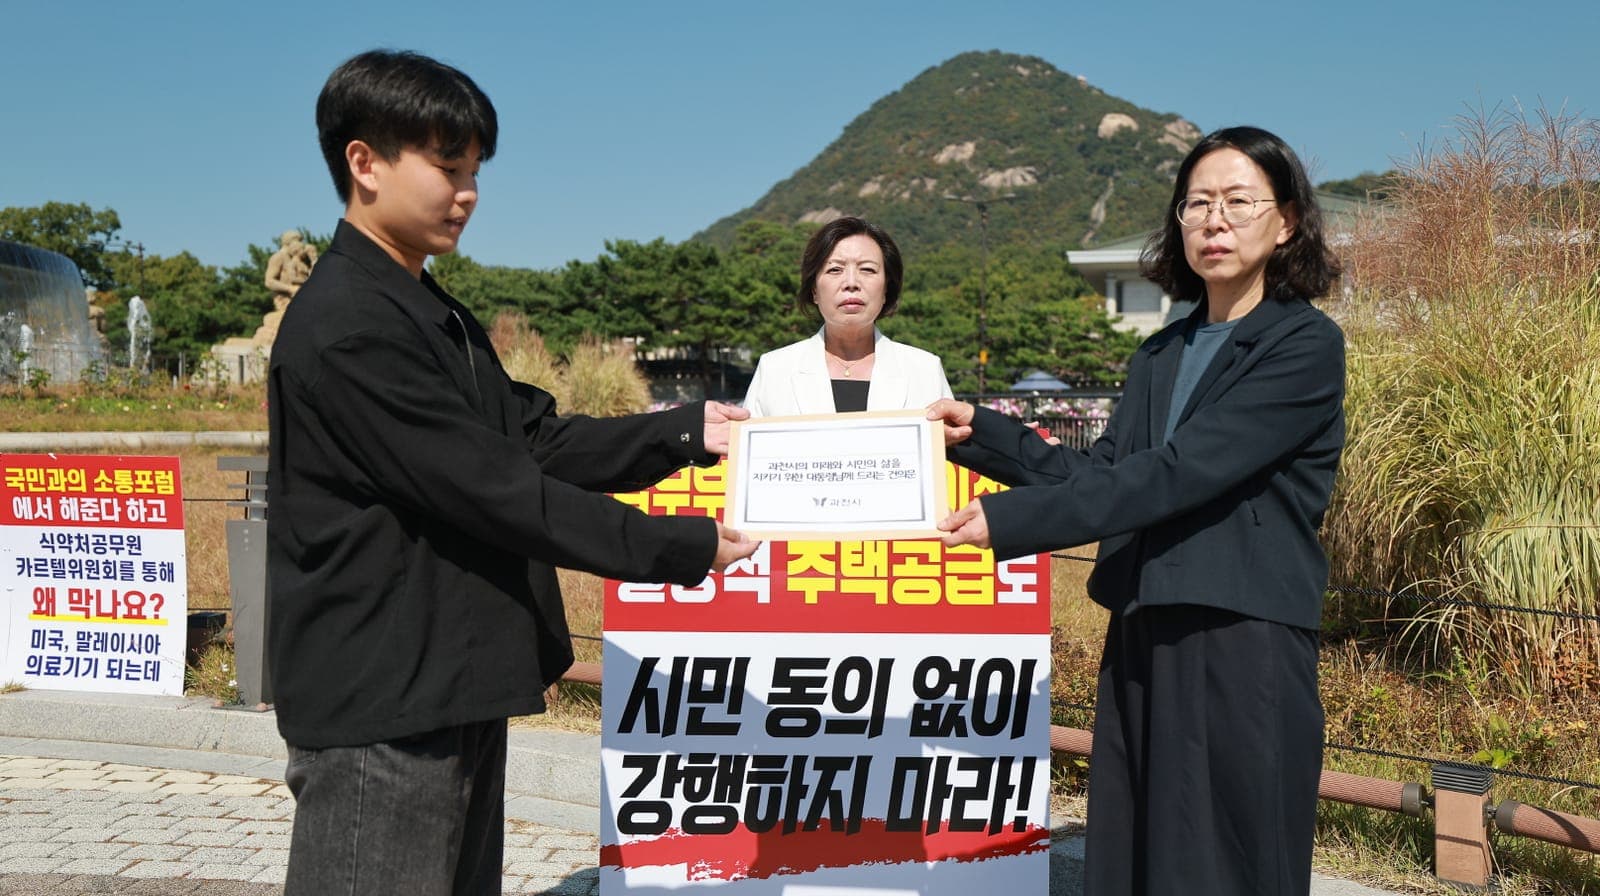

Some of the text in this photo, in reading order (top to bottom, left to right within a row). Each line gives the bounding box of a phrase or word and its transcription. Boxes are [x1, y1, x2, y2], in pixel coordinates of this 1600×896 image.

[752, 469, 917, 482] 지키기 위한 대통령님께 드리는 건의문
[768, 458, 901, 471] 과천시의 미래와 시민의 삶을
[5, 468, 175, 495] 국민과의 소통포럼
[13, 496, 167, 523] 에서 해준다 하고
[829, 498, 862, 507] 과천시
[39, 532, 142, 556] 식약처공무원
[16, 557, 175, 583] 카르텔위원회를 통해
[33, 587, 165, 620] 왜 막나요?
[31, 629, 161, 655] 미국, 말레이시아
[25, 655, 160, 682] 의료기기 되는데
[617, 655, 1038, 740] 시민 동의 없이
[616, 752, 1038, 837] 강행하지 마라!
